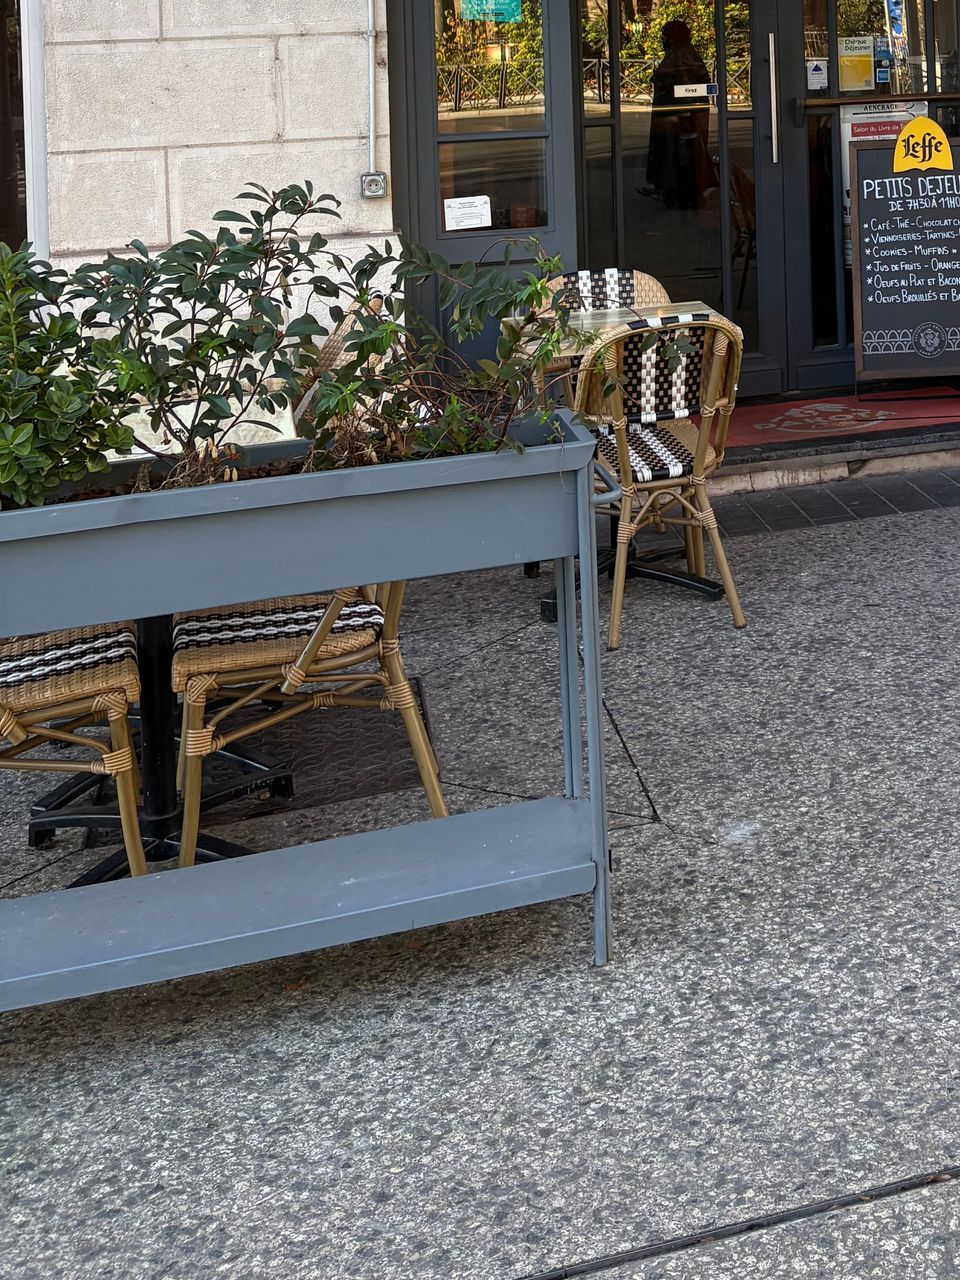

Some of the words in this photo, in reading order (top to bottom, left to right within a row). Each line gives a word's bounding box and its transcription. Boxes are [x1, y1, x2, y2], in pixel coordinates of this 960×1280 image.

[878, 124, 890, 132] Livre
[901, 132, 943, 163] Leffe
[863, 177, 912, 199] PETITS
[888, 200, 904, 211] DE
[907, 198, 931, 210] 7H30
[873, 260, 890, 272] JUS
[891, 263, 900, 271] DE
[931, 257, 960, 271] ORANGE
[874, 274, 900, 288] OEUFS
[900, 279, 908, 287] AU
[909, 273, 925, 287] PLAT
[927, 278, 936, 286] ET
[874, 290, 901, 304] OEUFS
[901, 289, 938, 303] BROUILLÉS
